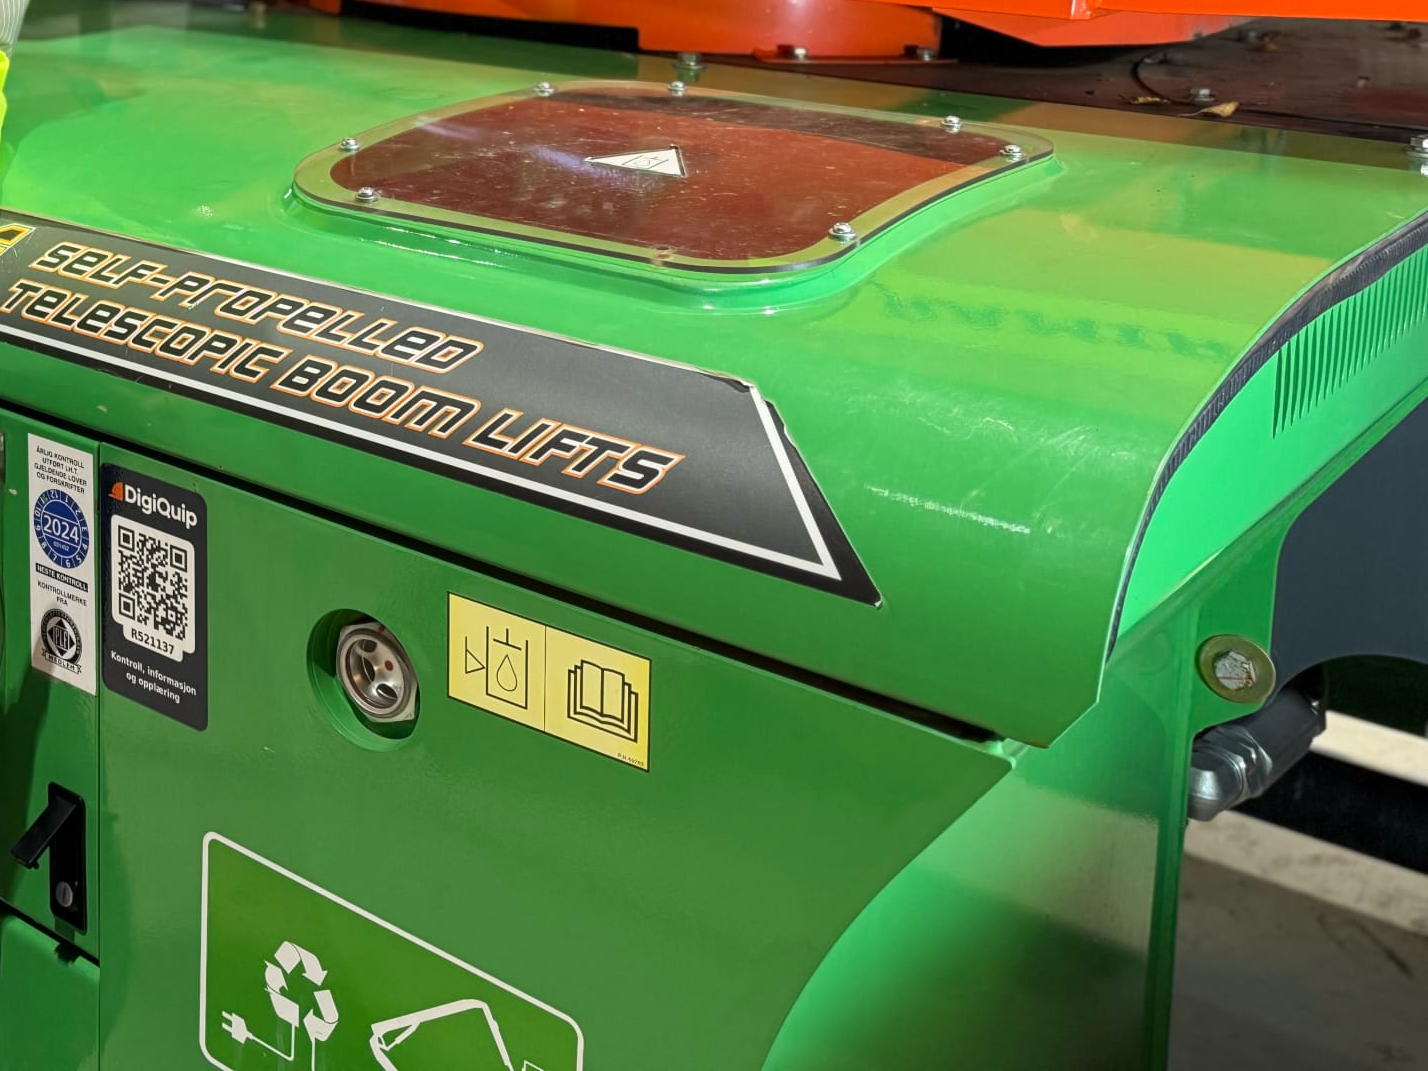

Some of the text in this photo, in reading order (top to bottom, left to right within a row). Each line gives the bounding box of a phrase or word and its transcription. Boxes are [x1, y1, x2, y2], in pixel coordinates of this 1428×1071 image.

[271, 355, 482, 439] BOOM
[463, 408, 686, 495] LIFTS
[36, 445, 85, 469] ÅRLIG KONTROLL
[34, 462, 87, 486] GJELDENDE LOVER
[36, 472, 85, 494] OG FORSKRIFTER
[124, 484, 198, 529] DigiQuip
[43, 515, 79, 543] 2024
[37, 564, 87, 591] NESTE KONTROLL
[37, 579, 87, 606] KONTROLLMERKE
[56, 596, 68, 606] FRA
[131, 628, 174, 654] R521137
[111, 649, 197, 696] Kontroll, informasjon
[126, 672, 180, 704] og opplæring
